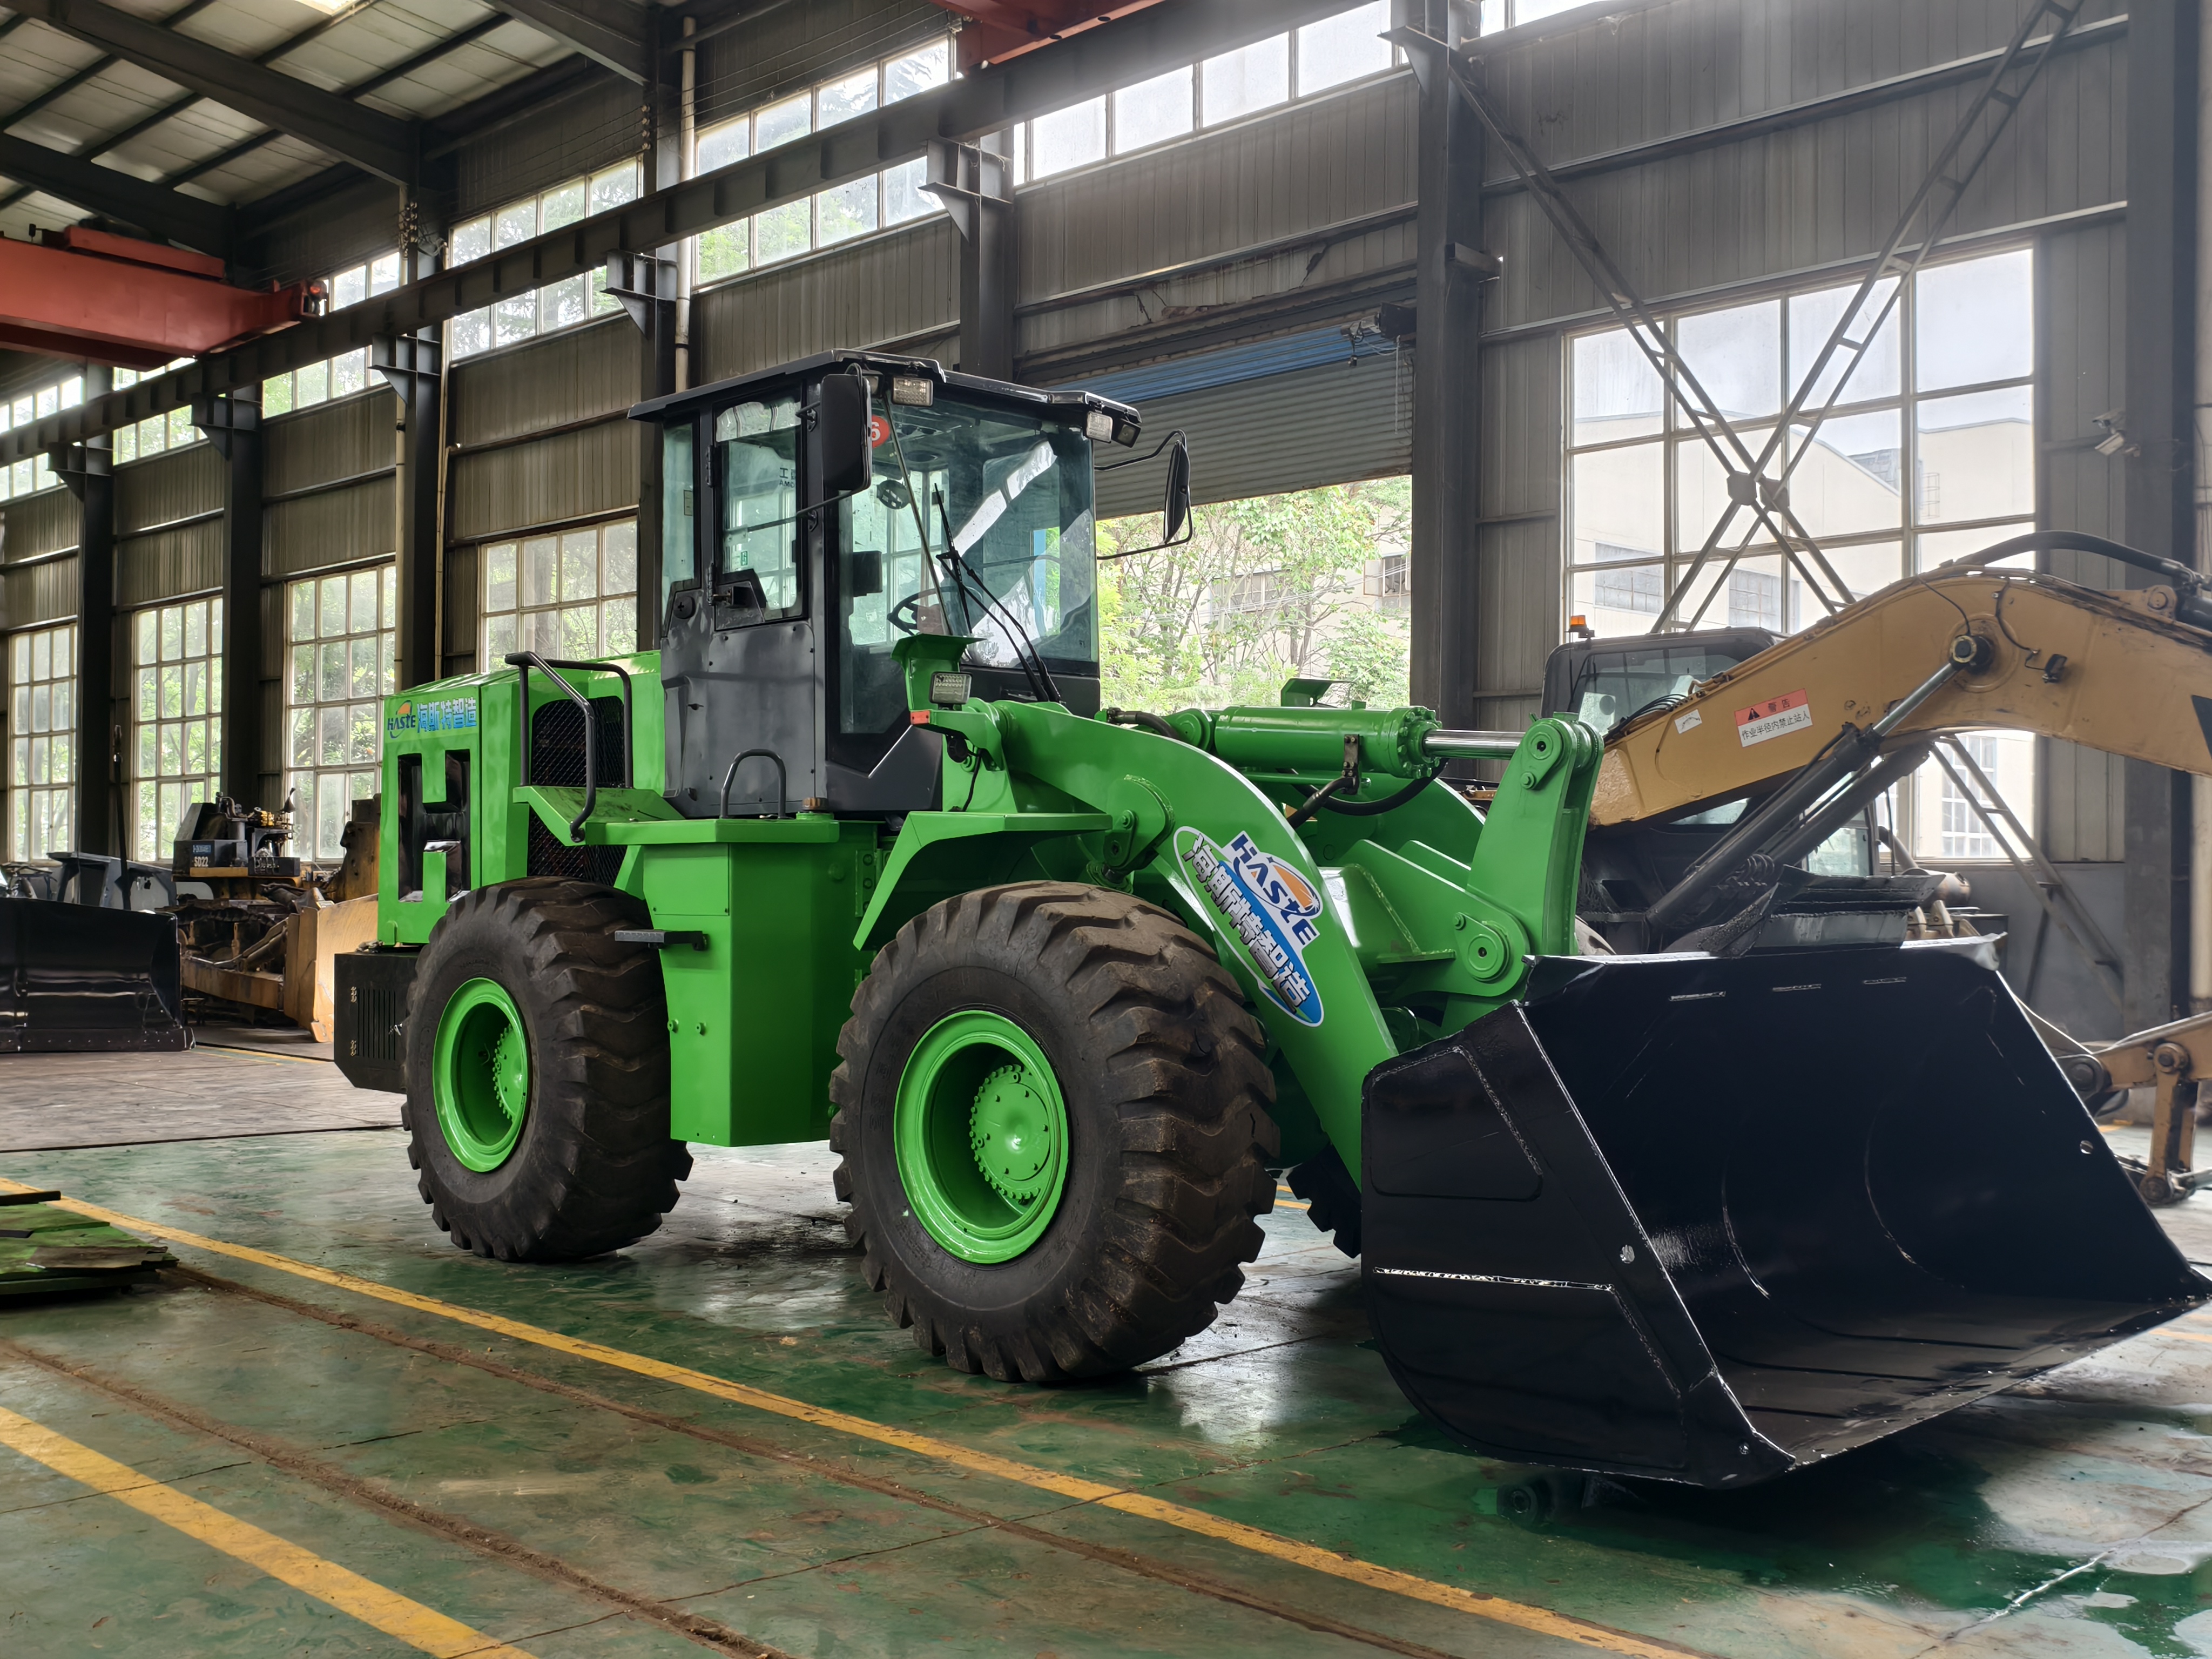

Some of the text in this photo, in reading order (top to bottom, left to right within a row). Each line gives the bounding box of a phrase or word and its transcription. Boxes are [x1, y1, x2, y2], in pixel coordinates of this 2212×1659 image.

[387, 713, 416, 731] HASTE
[417, 697, 477, 733] 海斯特智造
[1742, 710, 1810, 740] 作业半径内禁止站人
[194, 856, 209, 867] SD22
[1230, 833, 1317, 945] HASTE
[1182, 833, 1311, 1014] 海斯特智造
